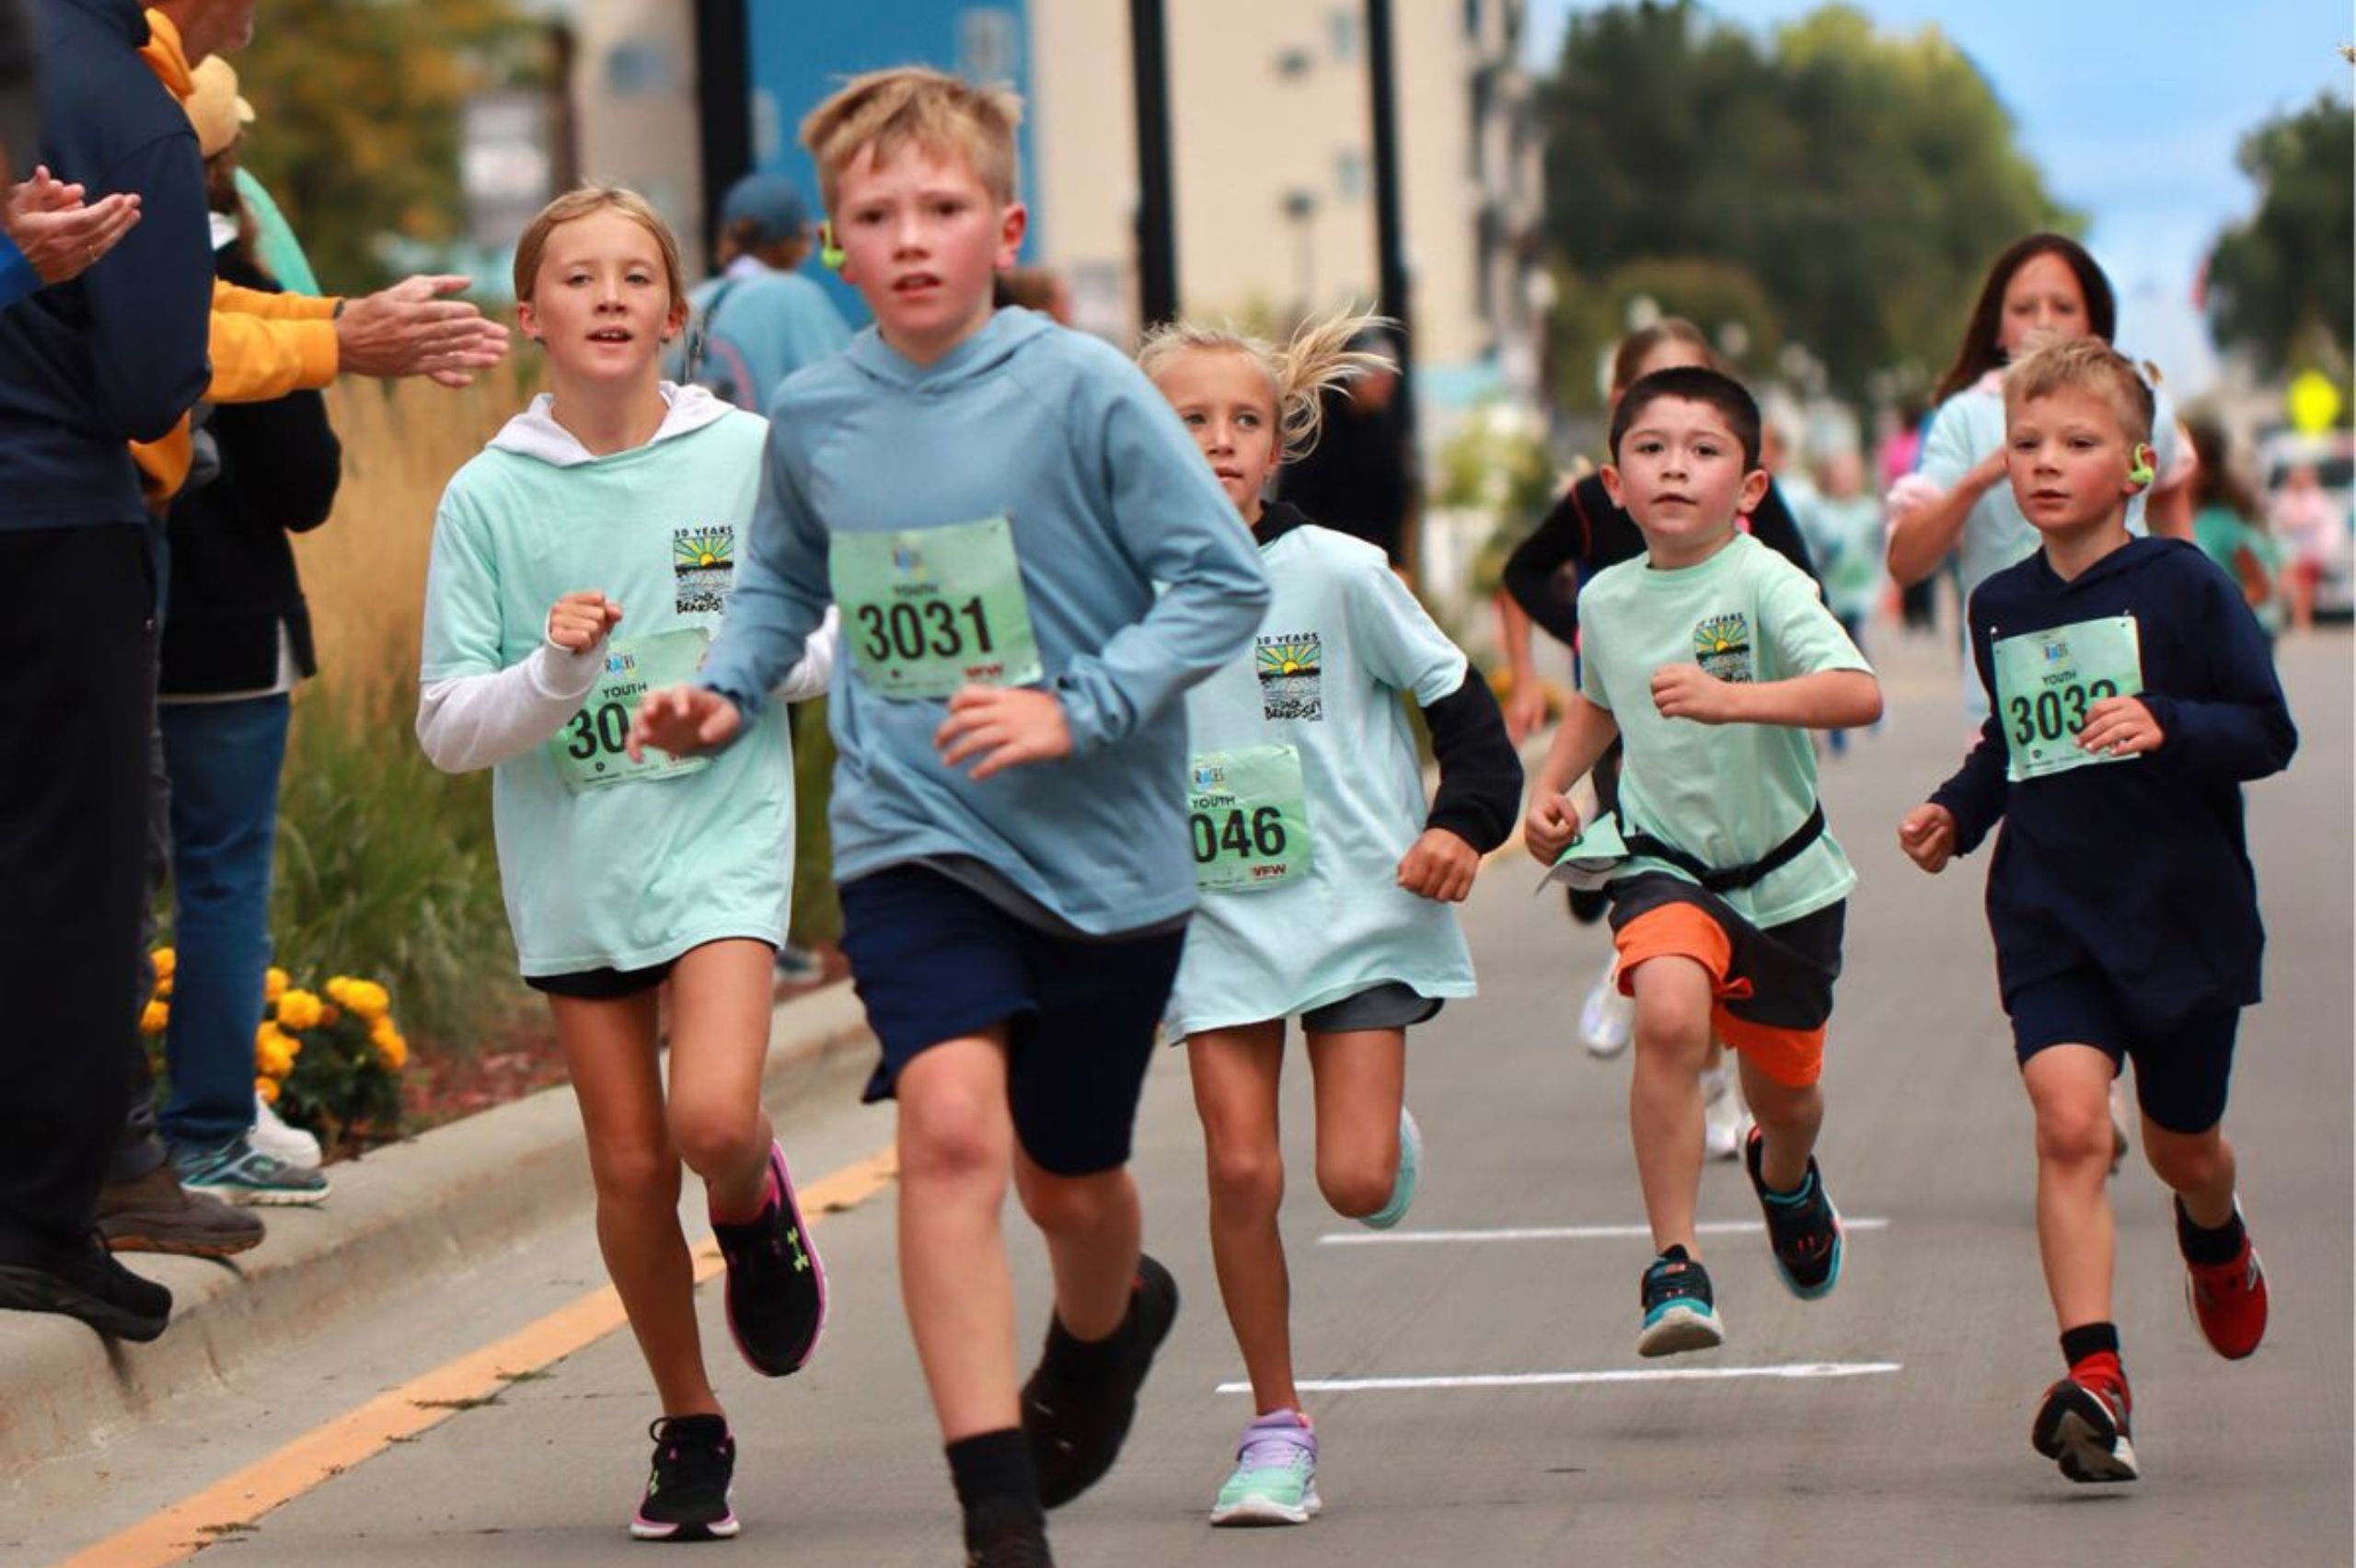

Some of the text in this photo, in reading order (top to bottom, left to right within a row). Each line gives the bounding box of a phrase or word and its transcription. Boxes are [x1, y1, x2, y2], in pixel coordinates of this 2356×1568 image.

[694, 525, 733, 536] YEARS
[859, 595, 994, 663] 3031
[1276, 632, 1319, 643] YEARS
[2041, 670, 2077, 686] YOUTH
[603, 682, 648, 699] YOUTH
[567, 702, 630, 760] 30
[1193, 795, 1235, 810] YOUTH
[1189, 806, 1287, 863] 046
